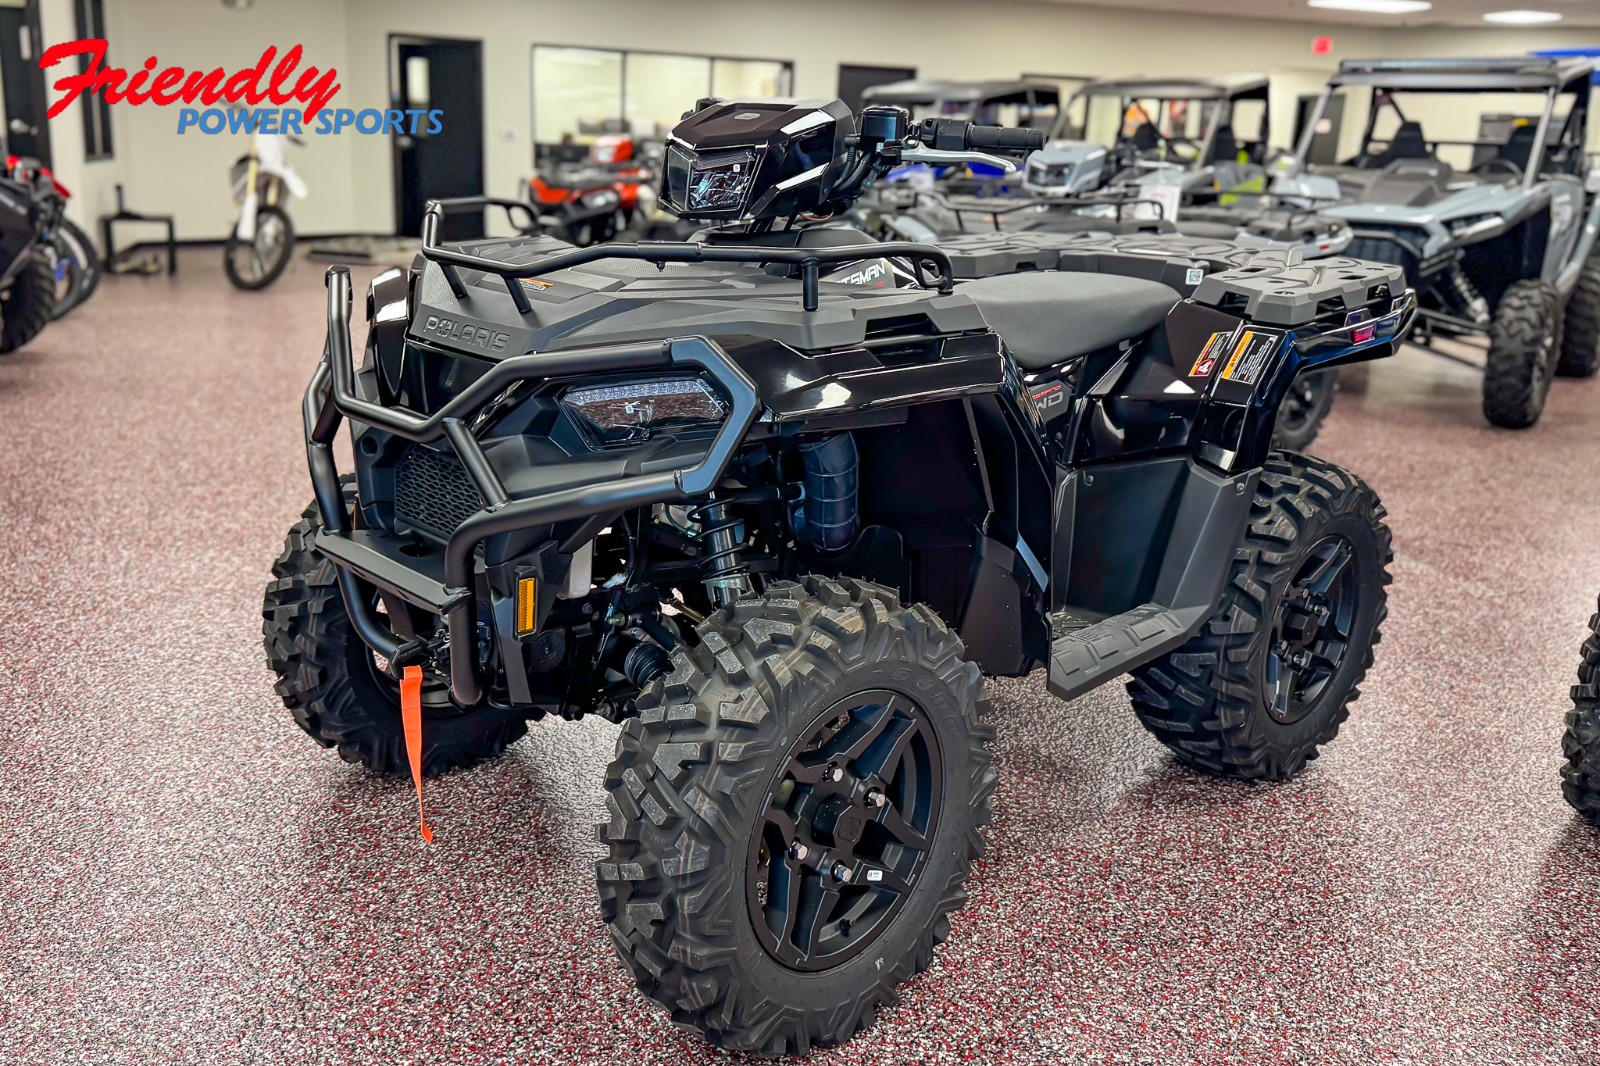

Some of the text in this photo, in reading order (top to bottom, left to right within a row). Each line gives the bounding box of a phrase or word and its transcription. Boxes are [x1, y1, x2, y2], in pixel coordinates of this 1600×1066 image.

[836, 261, 886, 284] TSMAN
[423, 314, 511, 352] POLARIS
[1034, 391, 1064, 410] WD
